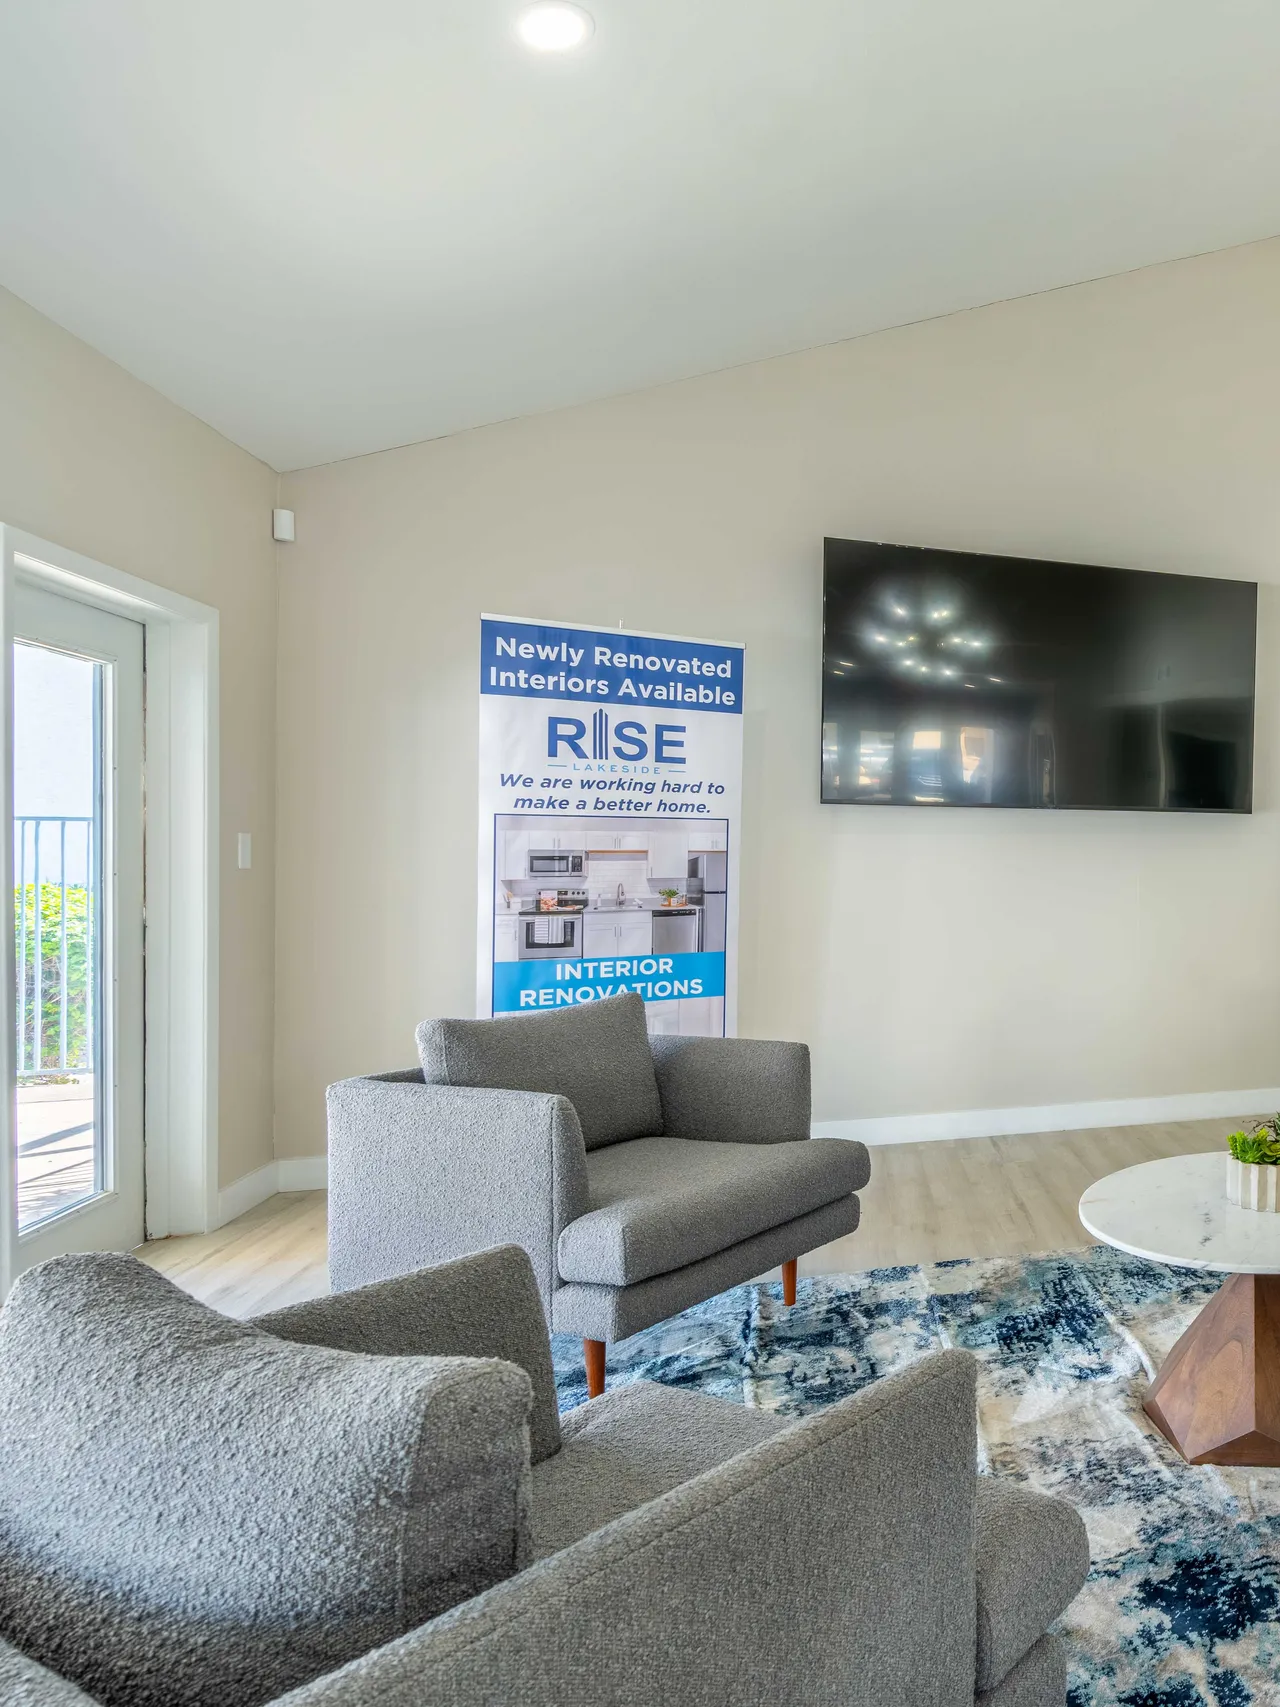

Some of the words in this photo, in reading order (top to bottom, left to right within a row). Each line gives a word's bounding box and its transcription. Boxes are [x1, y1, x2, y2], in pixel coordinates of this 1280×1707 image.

[495, 636, 584, 667] Newly
[594, 646, 732, 678] Renovated
[490, 667, 609, 695] Interiors
[617, 678, 736, 705] Available
[547, 707, 687, 764] RISE
[573, 763, 661, 774] LAKESIDE
[500, 773, 534, 788] We
[540, 775, 573, 789] are
[580, 777, 656, 794] working
[661, 779, 703, 794] hard
[708, 782, 725, 794] to
[513, 796, 570, 810] make
[576, 799, 588, 811] a
[593, 798, 652, 812] better
[656, 799, 712, 814] home.
[556, 957, 674, 981] INTERIOR
[519, 978, 704, 1007] RENOVATIONS
